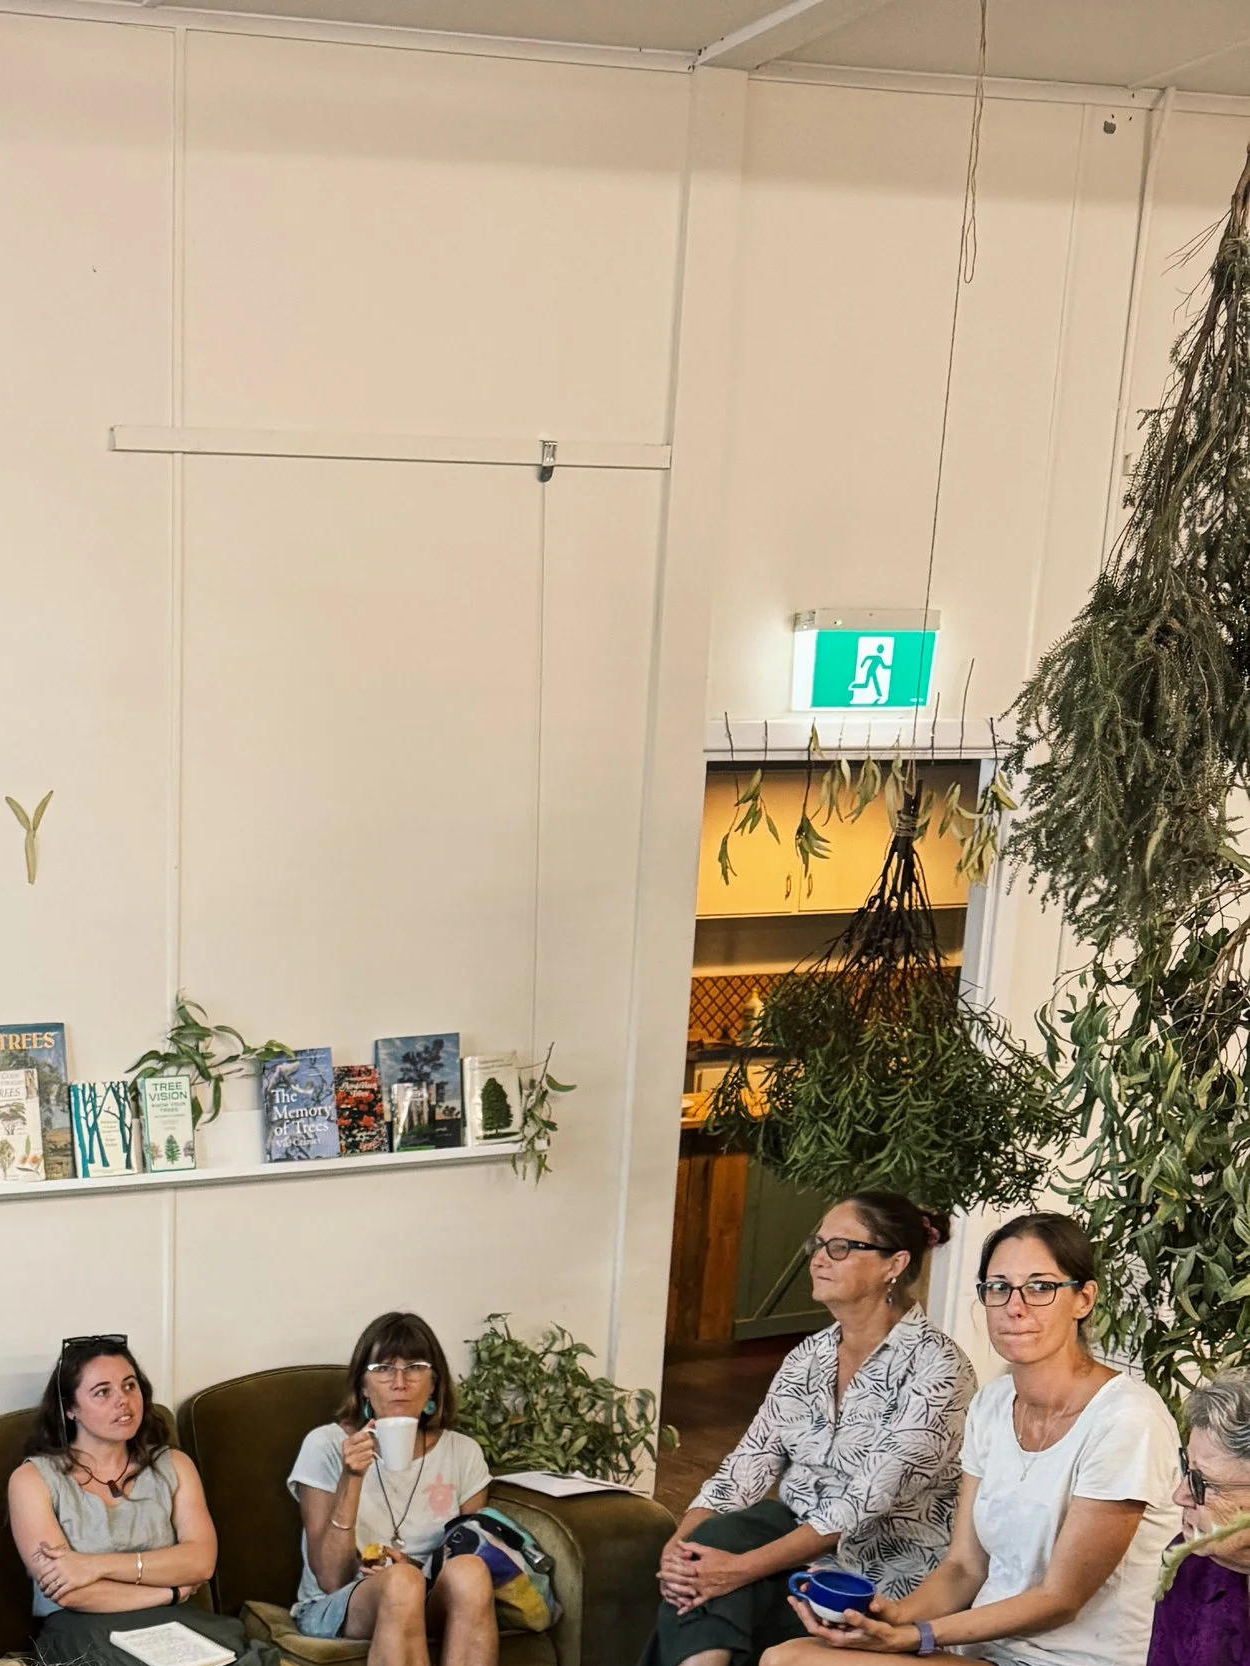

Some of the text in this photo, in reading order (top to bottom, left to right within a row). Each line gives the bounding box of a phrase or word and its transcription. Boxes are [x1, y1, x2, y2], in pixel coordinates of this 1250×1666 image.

[151, 1082, 183, 1092] TREE
[148, 1091, 188, 1101] VISION
[271, 1088, 297, 1104] The
[273, 1105, 331, 1121] Memory
[274, 1120, 330, 1136] of Trees
